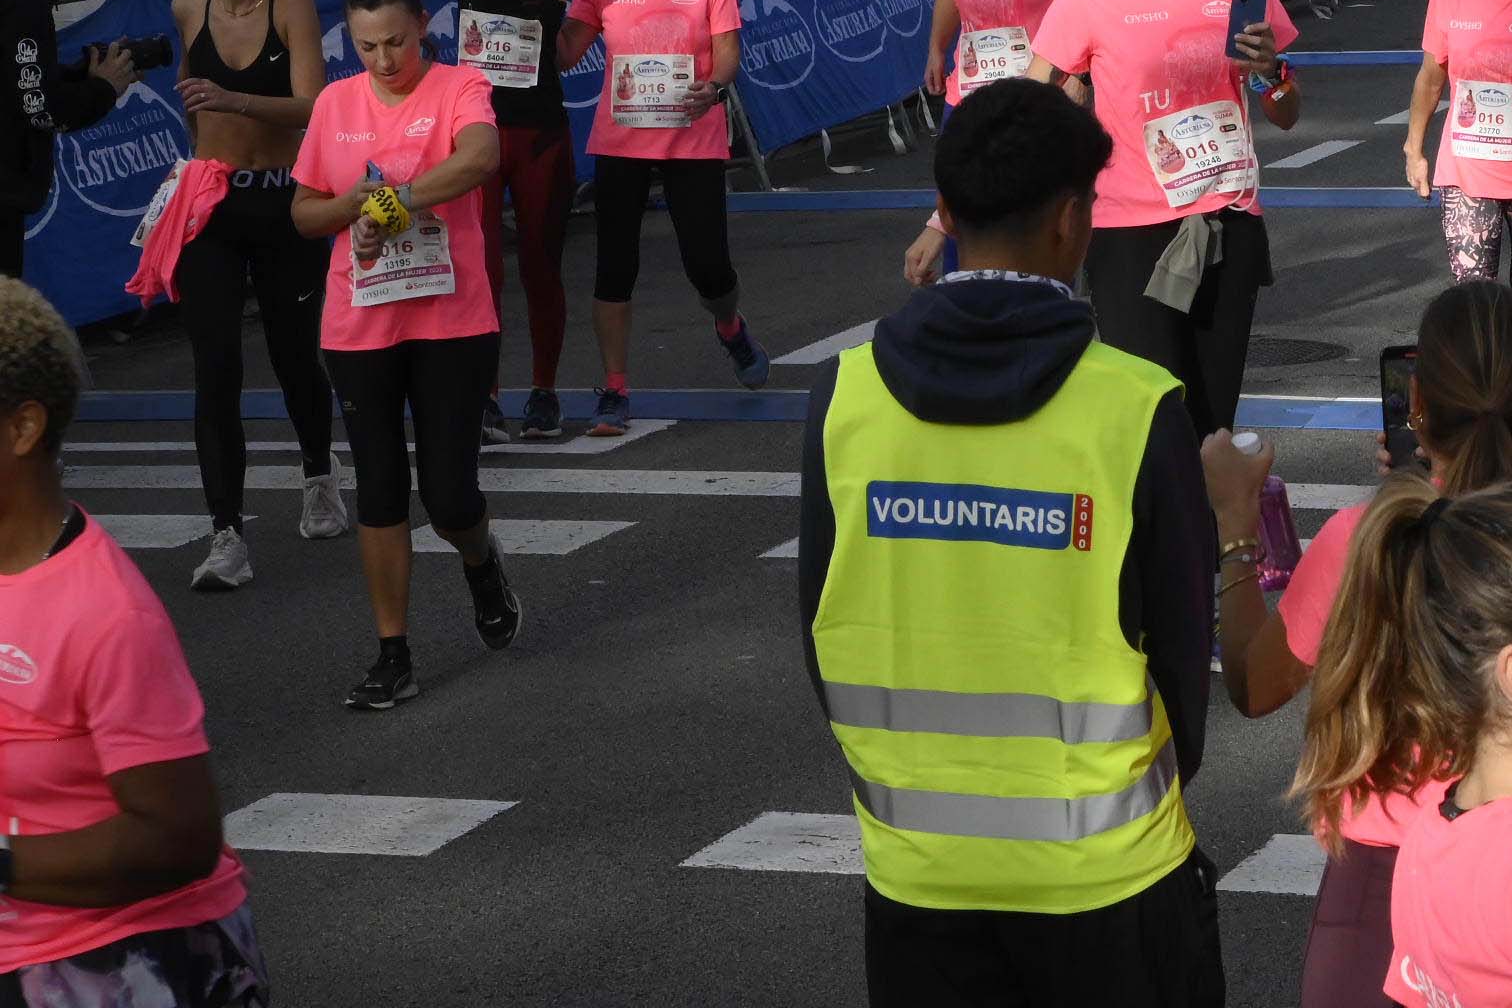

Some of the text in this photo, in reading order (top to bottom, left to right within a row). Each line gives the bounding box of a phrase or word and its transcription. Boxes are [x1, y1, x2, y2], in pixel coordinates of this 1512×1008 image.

[486, 41, 511, 52] 016
[980, 57, 1007, 70] 016
[638, 83, 666, 94] 016
[1140, 89, 1170, 113] TU
[1479, 112, 1504, 124] 016
[1185, 140, 1219, 160] 016
[1195, 155, 1222, 170] 19248
[262, 166, 291, 188] NI
[1174, 173, 1202, 187] CARRERA
[1202, 170, 1211, 179] DE
[1211, 168, 1219, 176] LA
[382, 240, 414, 258] 016
[384, 258, 411, 270] 13195
[872, 496, 1066, 535] VOLUNTARIS
[1079, 496, 1089, 550] 2000
